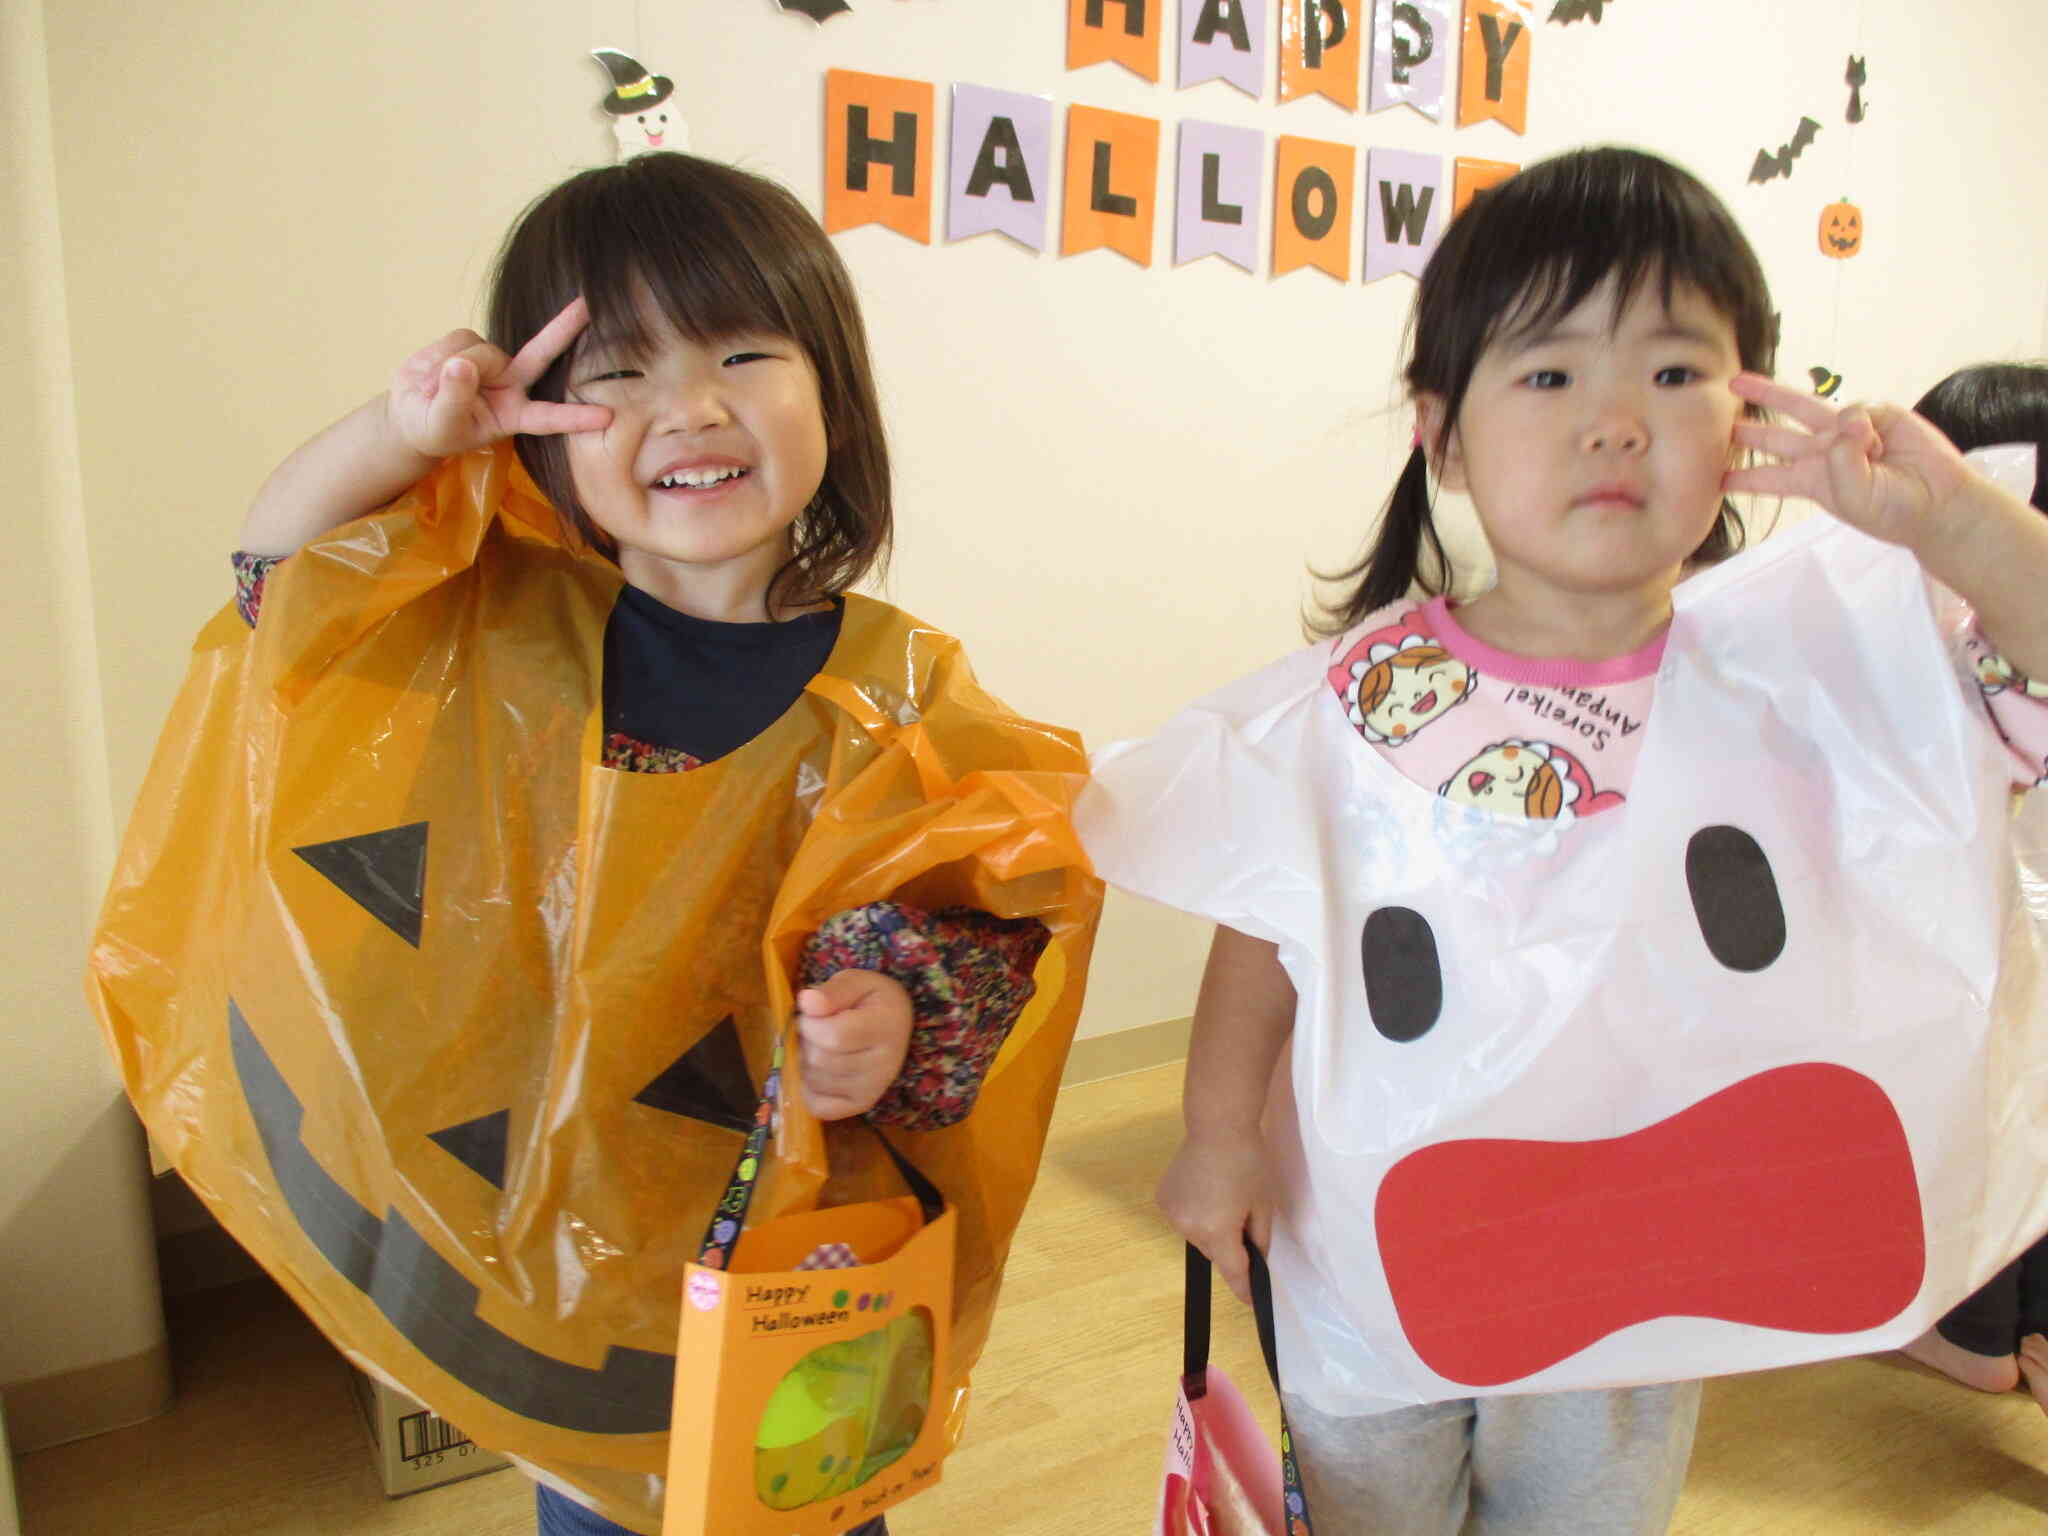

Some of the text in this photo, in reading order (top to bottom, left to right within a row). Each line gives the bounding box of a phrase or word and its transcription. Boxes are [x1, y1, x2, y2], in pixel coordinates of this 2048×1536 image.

[846, 104, 1495, 247] HALLOW
[1552, 684, 1642, 737] Anpan
[746, 1285, 810, 1306] Happy
[752, 1311, 848, 1331] Halloween
[413, 1452, 446, 1471] 325
